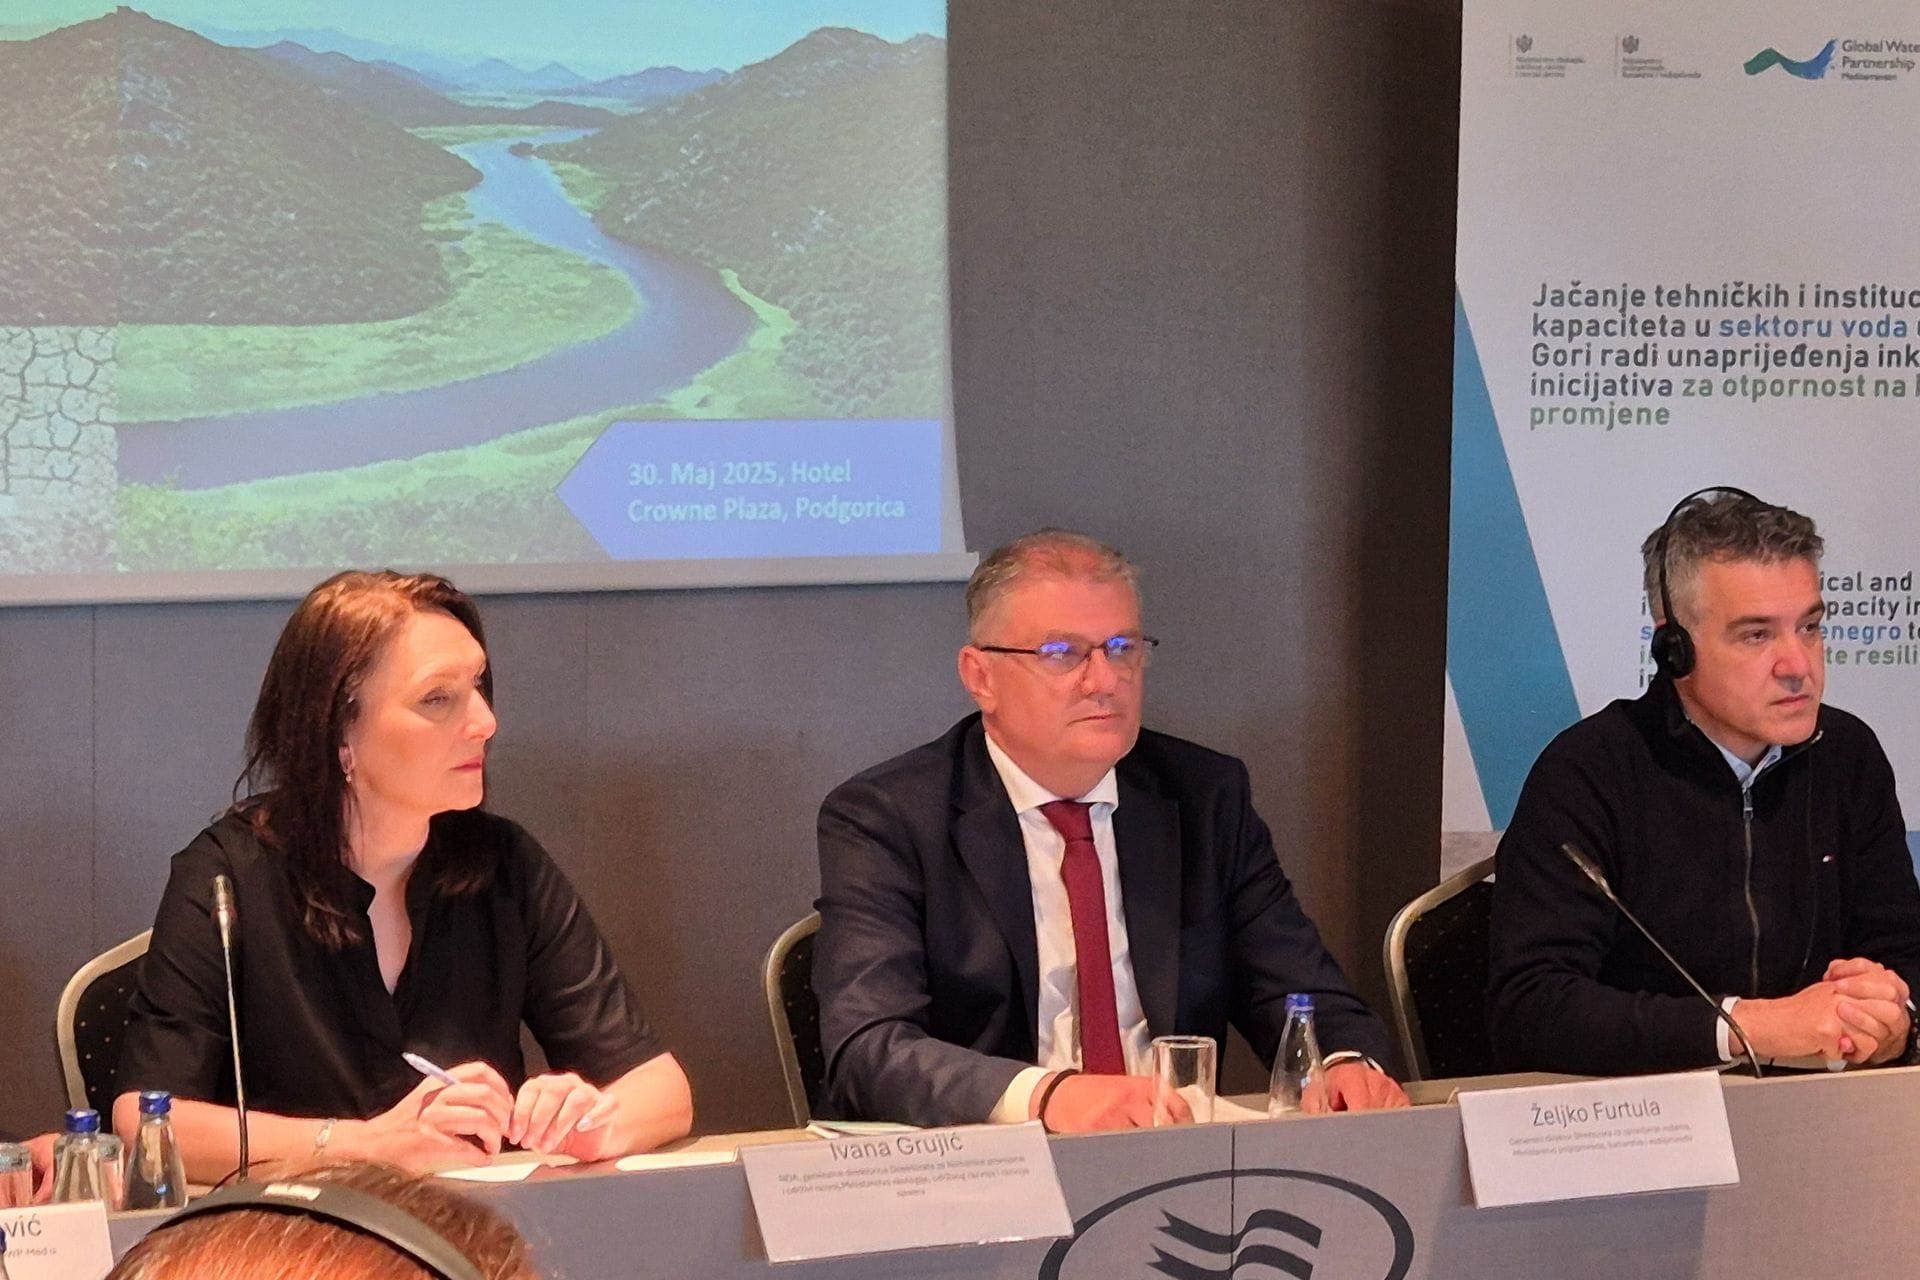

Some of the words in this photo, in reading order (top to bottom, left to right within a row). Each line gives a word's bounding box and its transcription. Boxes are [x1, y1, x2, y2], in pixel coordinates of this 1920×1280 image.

[1842, 40, 1883, 53] Global
[1842, 55, 1916, 72] Partnership
[1532, 280, 1646, 314] Jačanje
[1655, 281, 1789, 308] tehničkih
[1798, 284, 1806, 308] i
[1532, 313, 1686, 343] kapaciteta
[1695, 319, 1711, 338] u
[1719, 313, 1832, 338] sektoru
[1841, 313, 1907, 338] voda
[1532, 342, 1592, 367] Gori
[1600, 342, 1658, 367] radi
[1667, 342, 1869, 373] unaprijeđenja
[1530, 372, 1673, 402] inicijativa
[1682, 379, 1713, 397] za
[1723, 374, 1866, 402] otpornost
[1874, 379, 1906, 397] na
[1530, 401, 1670, 431] promjene
[627, 463, 664, 485] 30.
[671, 461, 715, 490] Maj
[723, 461, 785, 487] 2025,
[791, 458, 851, 483] Hotel
[628, 499, 717, 522] Crowne
[724, 496, 788, 523] Plaza,
[796, 494, 905, 524] Podgorica
[1870, 571, 1912, 591] and
[1531, 1102, 1589, 1128] Željko
[1593, 1098, 1661, 1120] Furtula
[830, 1141, 891, 1160] Ivana
[896, 1132, 963, 1157] Grujić
